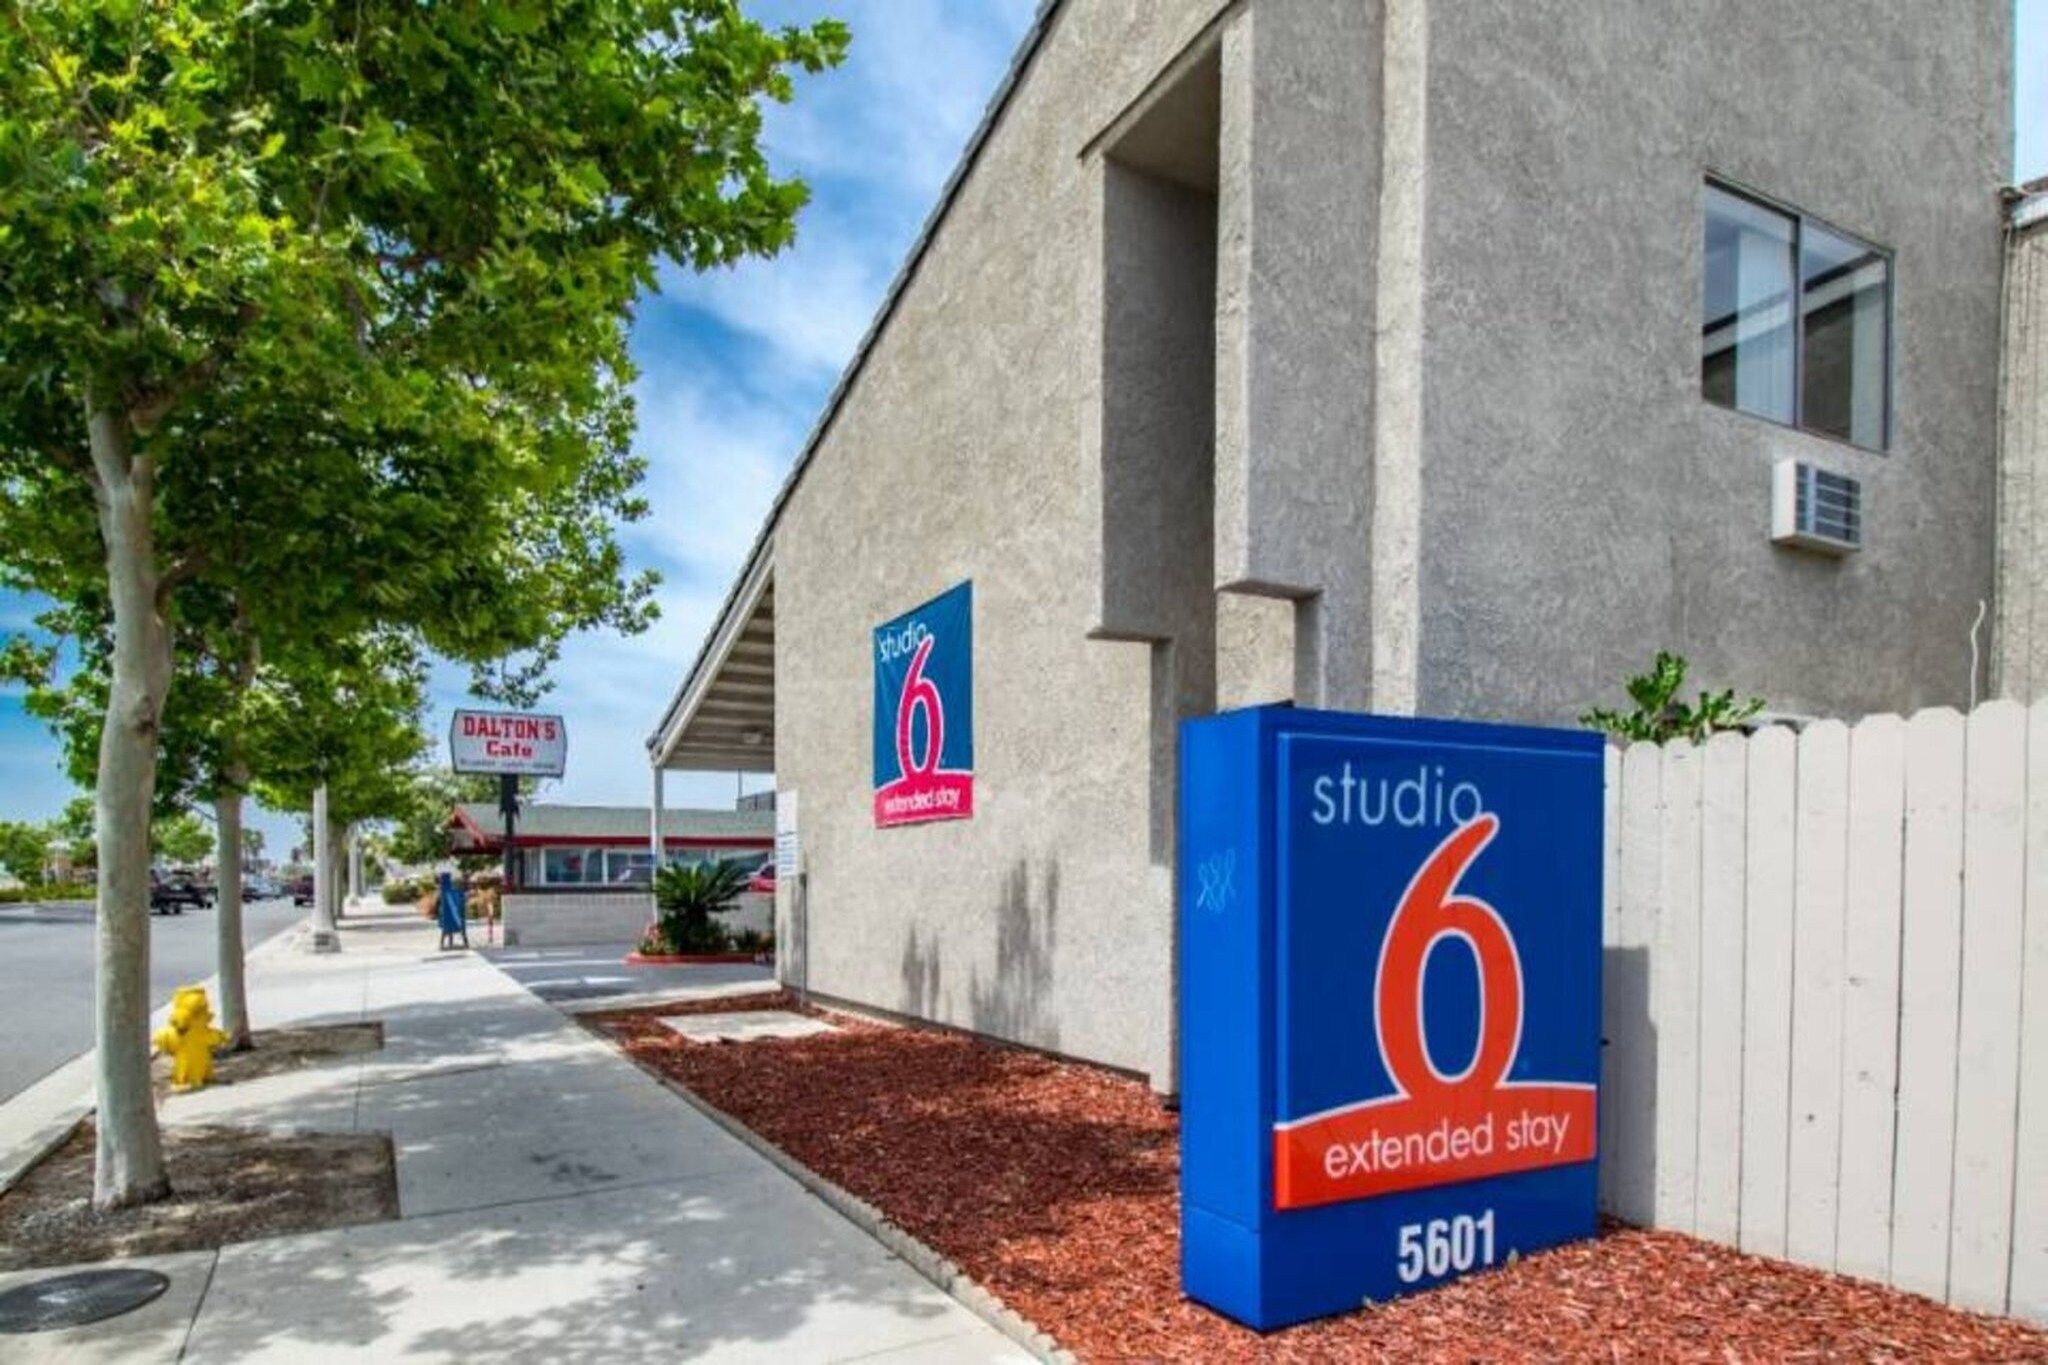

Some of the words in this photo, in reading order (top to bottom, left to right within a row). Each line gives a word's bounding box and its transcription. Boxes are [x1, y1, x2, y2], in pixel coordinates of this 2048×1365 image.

[880, 620, 927, 663] studio
[463, 716, 556, 741] DALTON'S
[896, 633, 944, 777] 6
[486, 740, 533, 757] Cafe
[1312, 761, 1482, 828] studio
[1374, 811, 1523, 1098] 6
[1324, 1112, 1494, 1179] extended
[1506, 1109, 1571, 1154] stay
[1396, 1208, 1495, 1283] 5601
